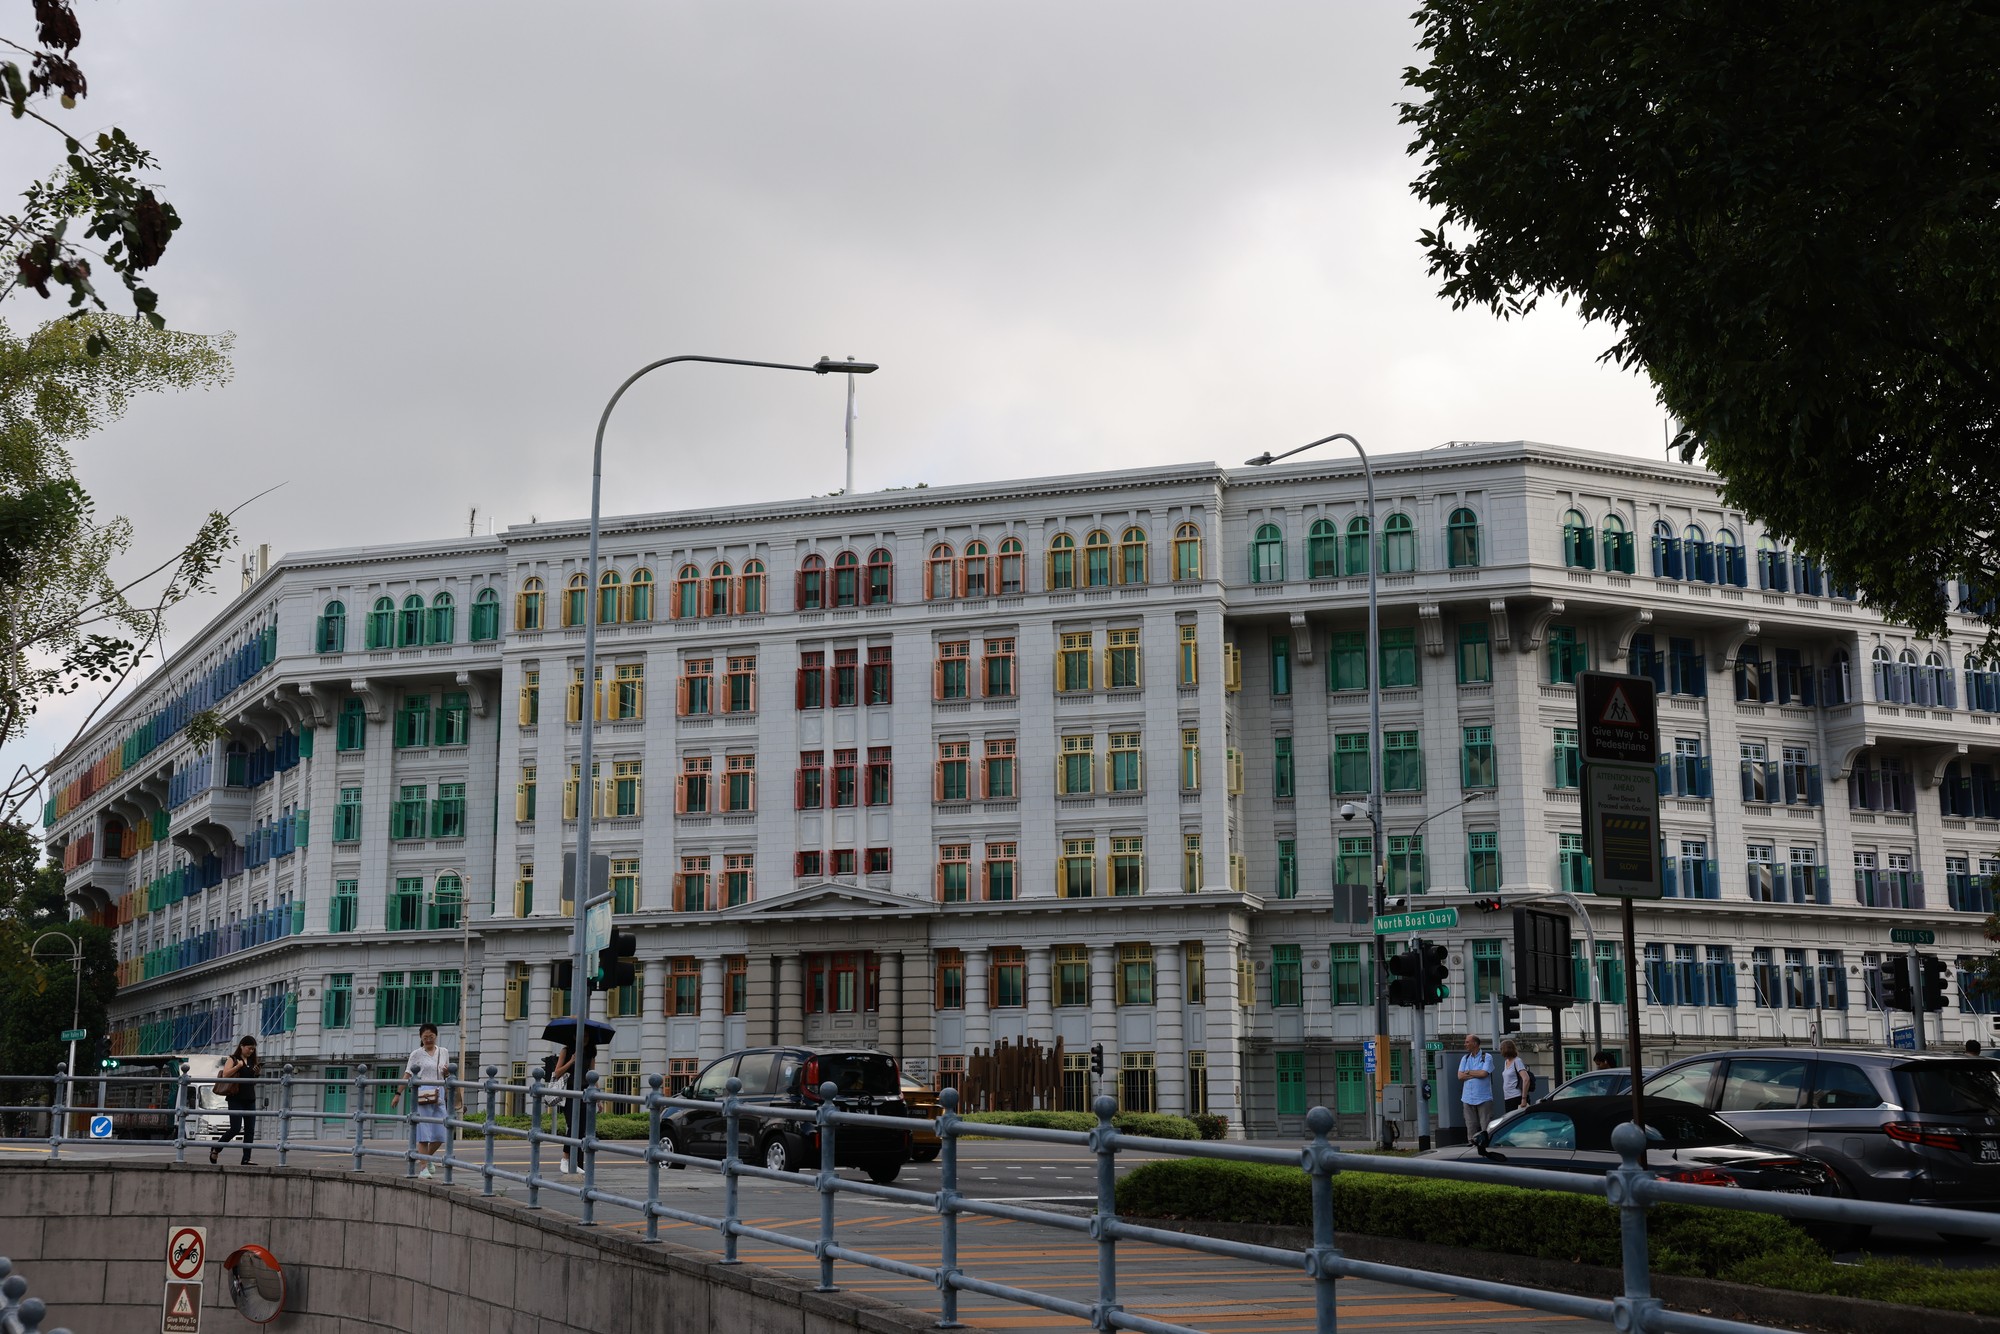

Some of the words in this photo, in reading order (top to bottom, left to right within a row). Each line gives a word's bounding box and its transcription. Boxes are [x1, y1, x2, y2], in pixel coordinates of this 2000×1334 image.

[1592, 727, 1611, 736] Give
[1616, 729, 1634, 740] Way
[1638, 731, 1649, 740] To
[1596, 738, 1646, 751] Pedestrians
[1597, 772, 1631, 782] ATTENTION
[1633, 775, 1650, 784] ZONE
[1613, 784, 1634, 792] AHEAD
[1619, 862, 1638, 871] SLOW
[1377, 916, 1402, 929] North
[1405, 914, 1426, 927] Boat
[1429, 913, 1452, 925] Quay
[1896, 930, 1915, 941] Hill
[1919, 931, 1929, 942] St
[1980, 1140, 1997, 1150] SMU
[167, 1323, 195, 1331] Pedestrians
